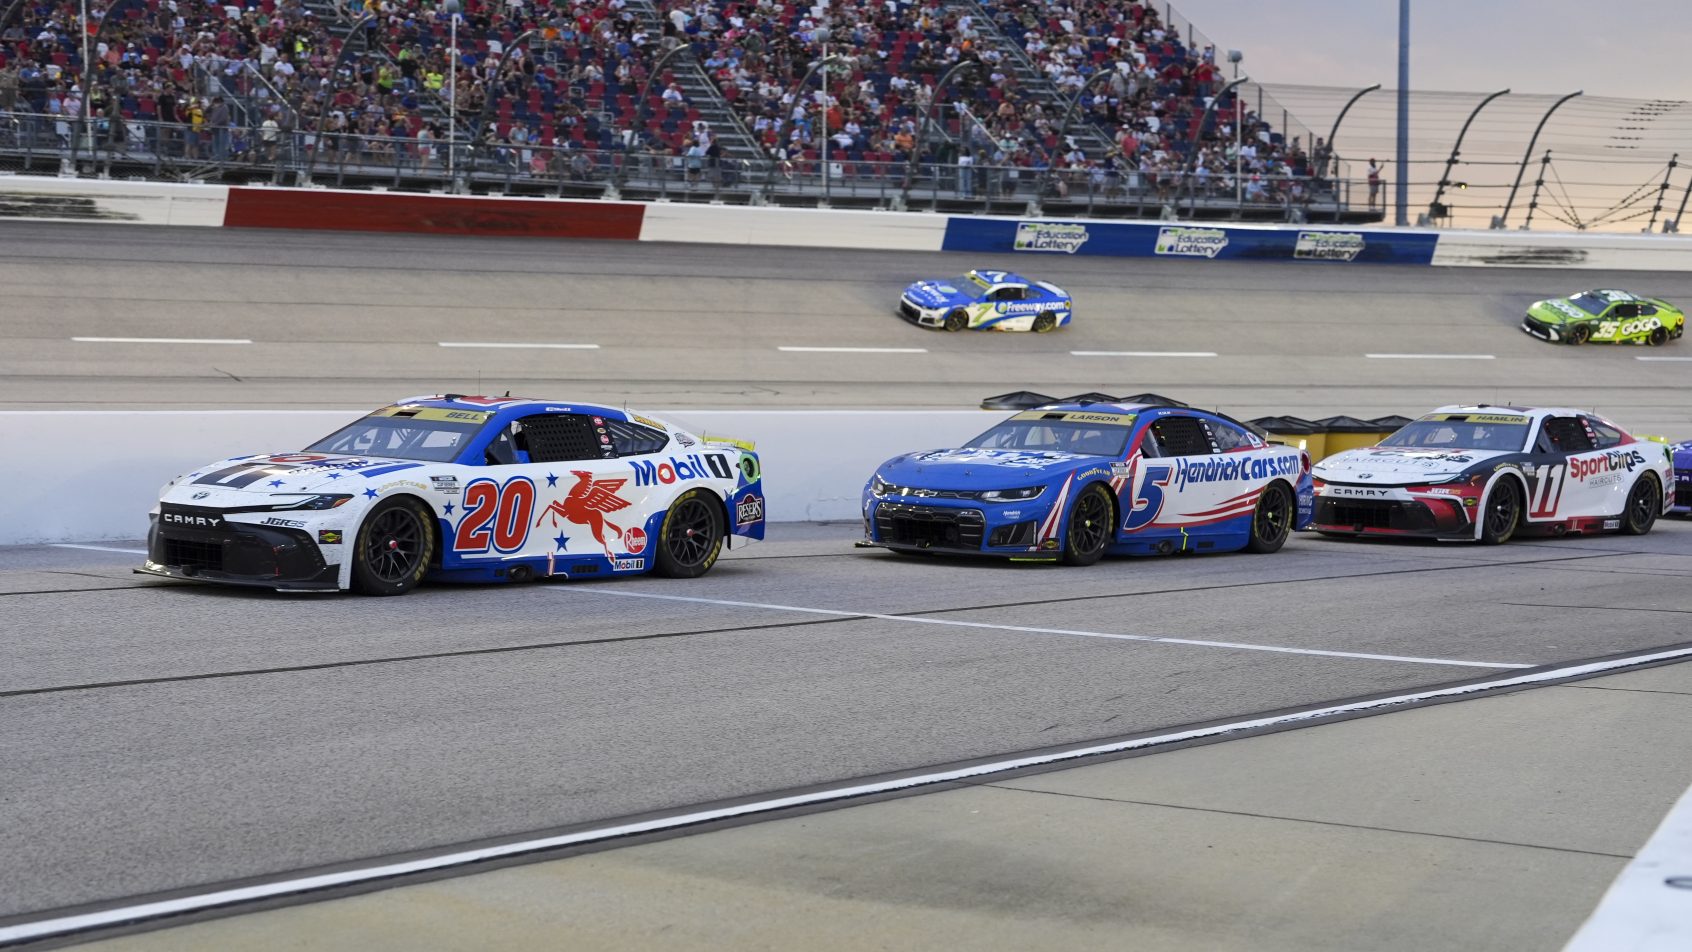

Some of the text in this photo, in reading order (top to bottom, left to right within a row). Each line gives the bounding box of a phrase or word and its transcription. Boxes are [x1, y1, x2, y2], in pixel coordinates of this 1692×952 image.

[1037, 231, 1087, 240] Education
[1178, 235, 1227, 245] Education
[1034, 240, 1079, 251] Lottery
[1175, 244, 1220, 255] Lottery
[1316, 240, 1365, 248] Education
[1313, 248, 1359, 260] Lottery
[986, 271, 1008, 282] 7
[973, 303, 995, 322] 7
[1007, 302, 1064, 313] Freeway.com
[1592, 321, 1620, 338] 35
[1621, 317, 1661, 336] GOGO
[446, 411, 479, 420] BELL
[1071, 414, 1120, 422] LARSON
[630, 454, 732, 486] Mobil 1
[1077, 467, 1111, 481] GOODYEAR
[1175, 454, 1299, 492] HendrickCars.com
[1590, 475, 1622, 487] HAIRCUTS
[1334, 488, 1388, 497] CAMRY
[1530, 465, 1564, 514] 11
[1123, 465, 1173, 533] 5
[454, 476, 536, 551] 20
[164, 513, 220, 527] CAMRY
[626, 528, 646, 550] Rheem
[615, 560, 643, 570] Mobil 1
